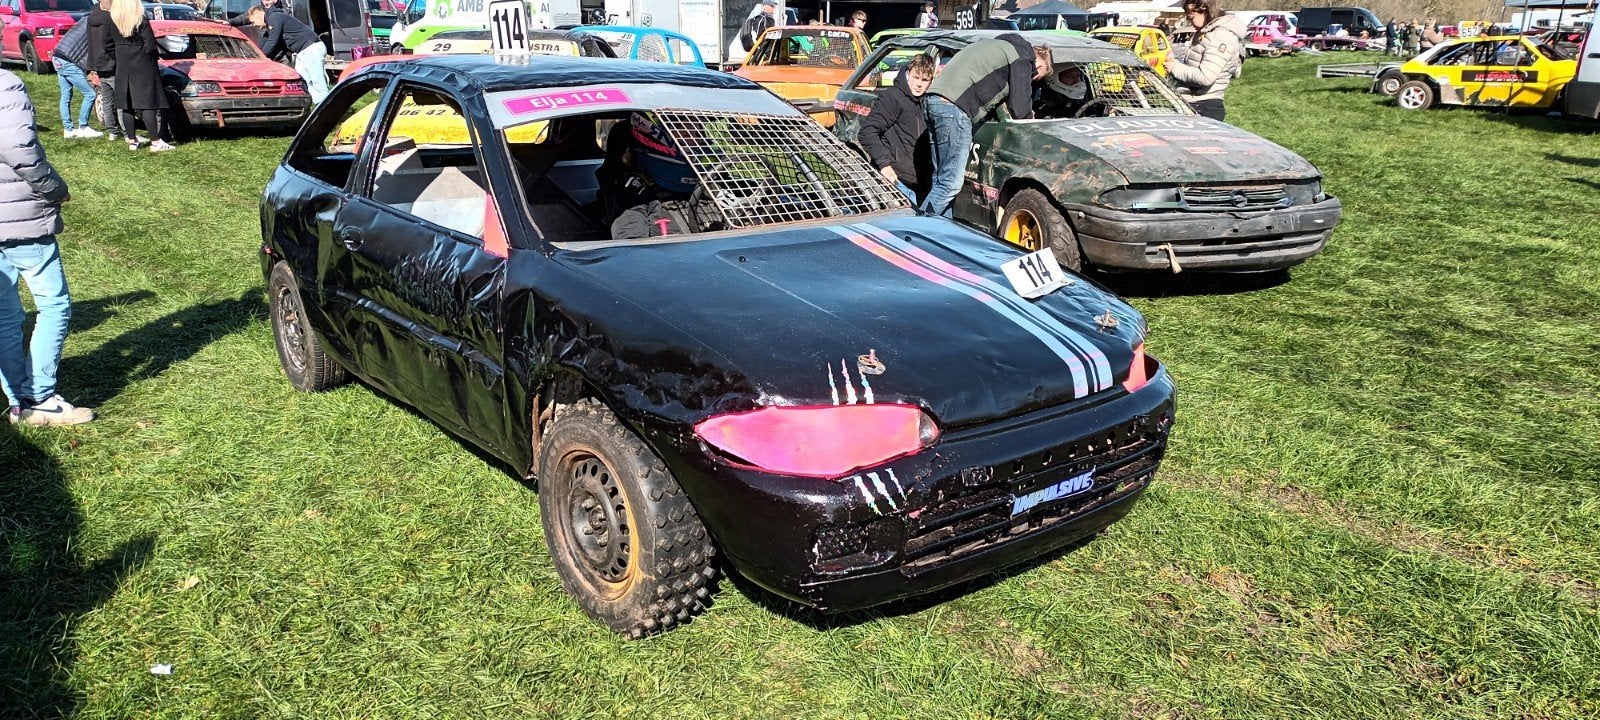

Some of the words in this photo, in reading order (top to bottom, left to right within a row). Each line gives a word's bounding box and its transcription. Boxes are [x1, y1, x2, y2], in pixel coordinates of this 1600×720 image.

[457, 0, 484, 12] AMB
[956, 10, 974, 29] 569
[492, 8, 525, 50] 114
[1461, 27, 1478, 37] 652
[432, 43, 452, 52] 29
[530, 96, 568, 109] Elja
[571, 91, 609, 103] 114
[1066, 120, 1115, 133] DL
[1018, 253, 1053, 288] 114
[1011, 471, 1094, 516] IMPULSIVE
